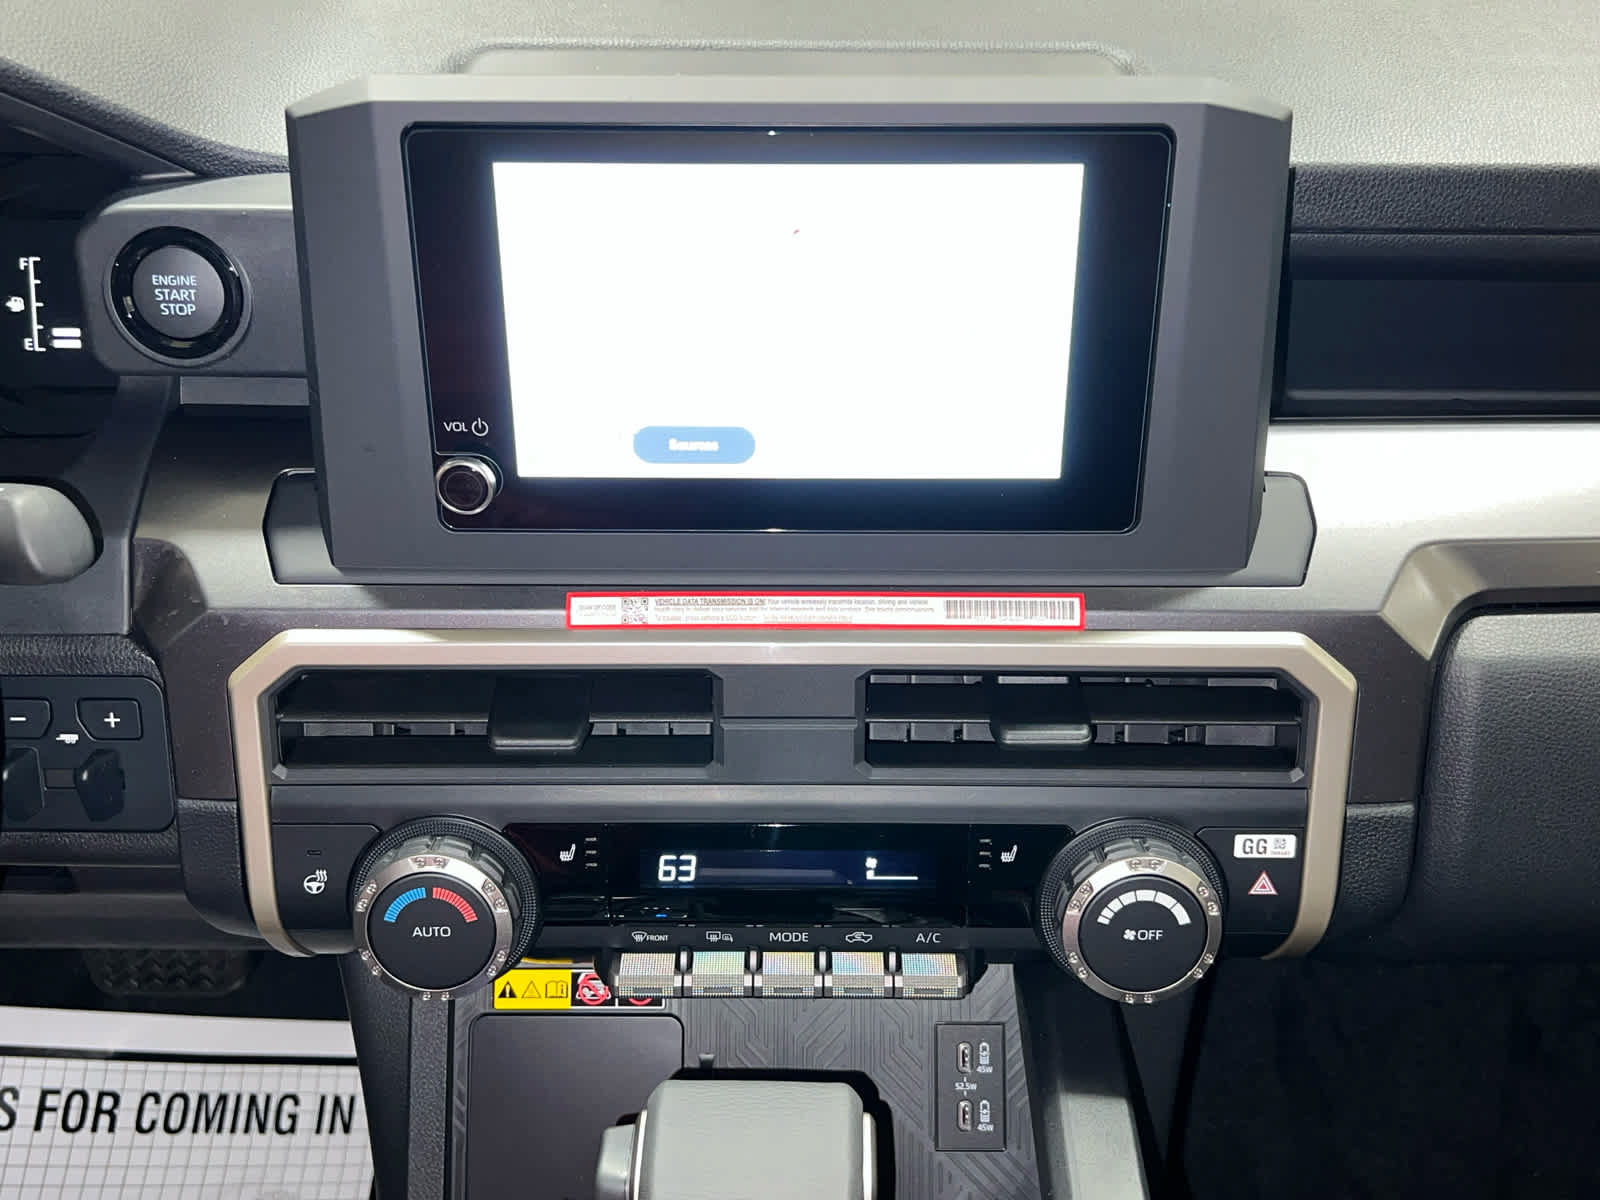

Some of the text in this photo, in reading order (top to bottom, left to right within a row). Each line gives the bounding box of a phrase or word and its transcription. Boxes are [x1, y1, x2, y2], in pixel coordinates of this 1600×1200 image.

[152, 274, 197, 286] ENGINE
[155, 289, 197, 301] START
[160, 303, 196, 316] STOP
[443, 421, 469, 432] VOL
[1242, 838, 1268, 855] GG
[658, 854, 698, 882] 63
[412, 926, 452, 938] AUTO
[646, 934, 669, 942] FRONT
[769, 932, 809, 942] MODE
[915, 932, 942, 944] A/C
[1137, 929, 1163, 941] OFF
[33, 1088, 121, 1135] FOR
[135, 1091, 300, 1135] COMING
[314, 1094, 356, 1135] IN
[977, 1124, 995, 1132] 45W
